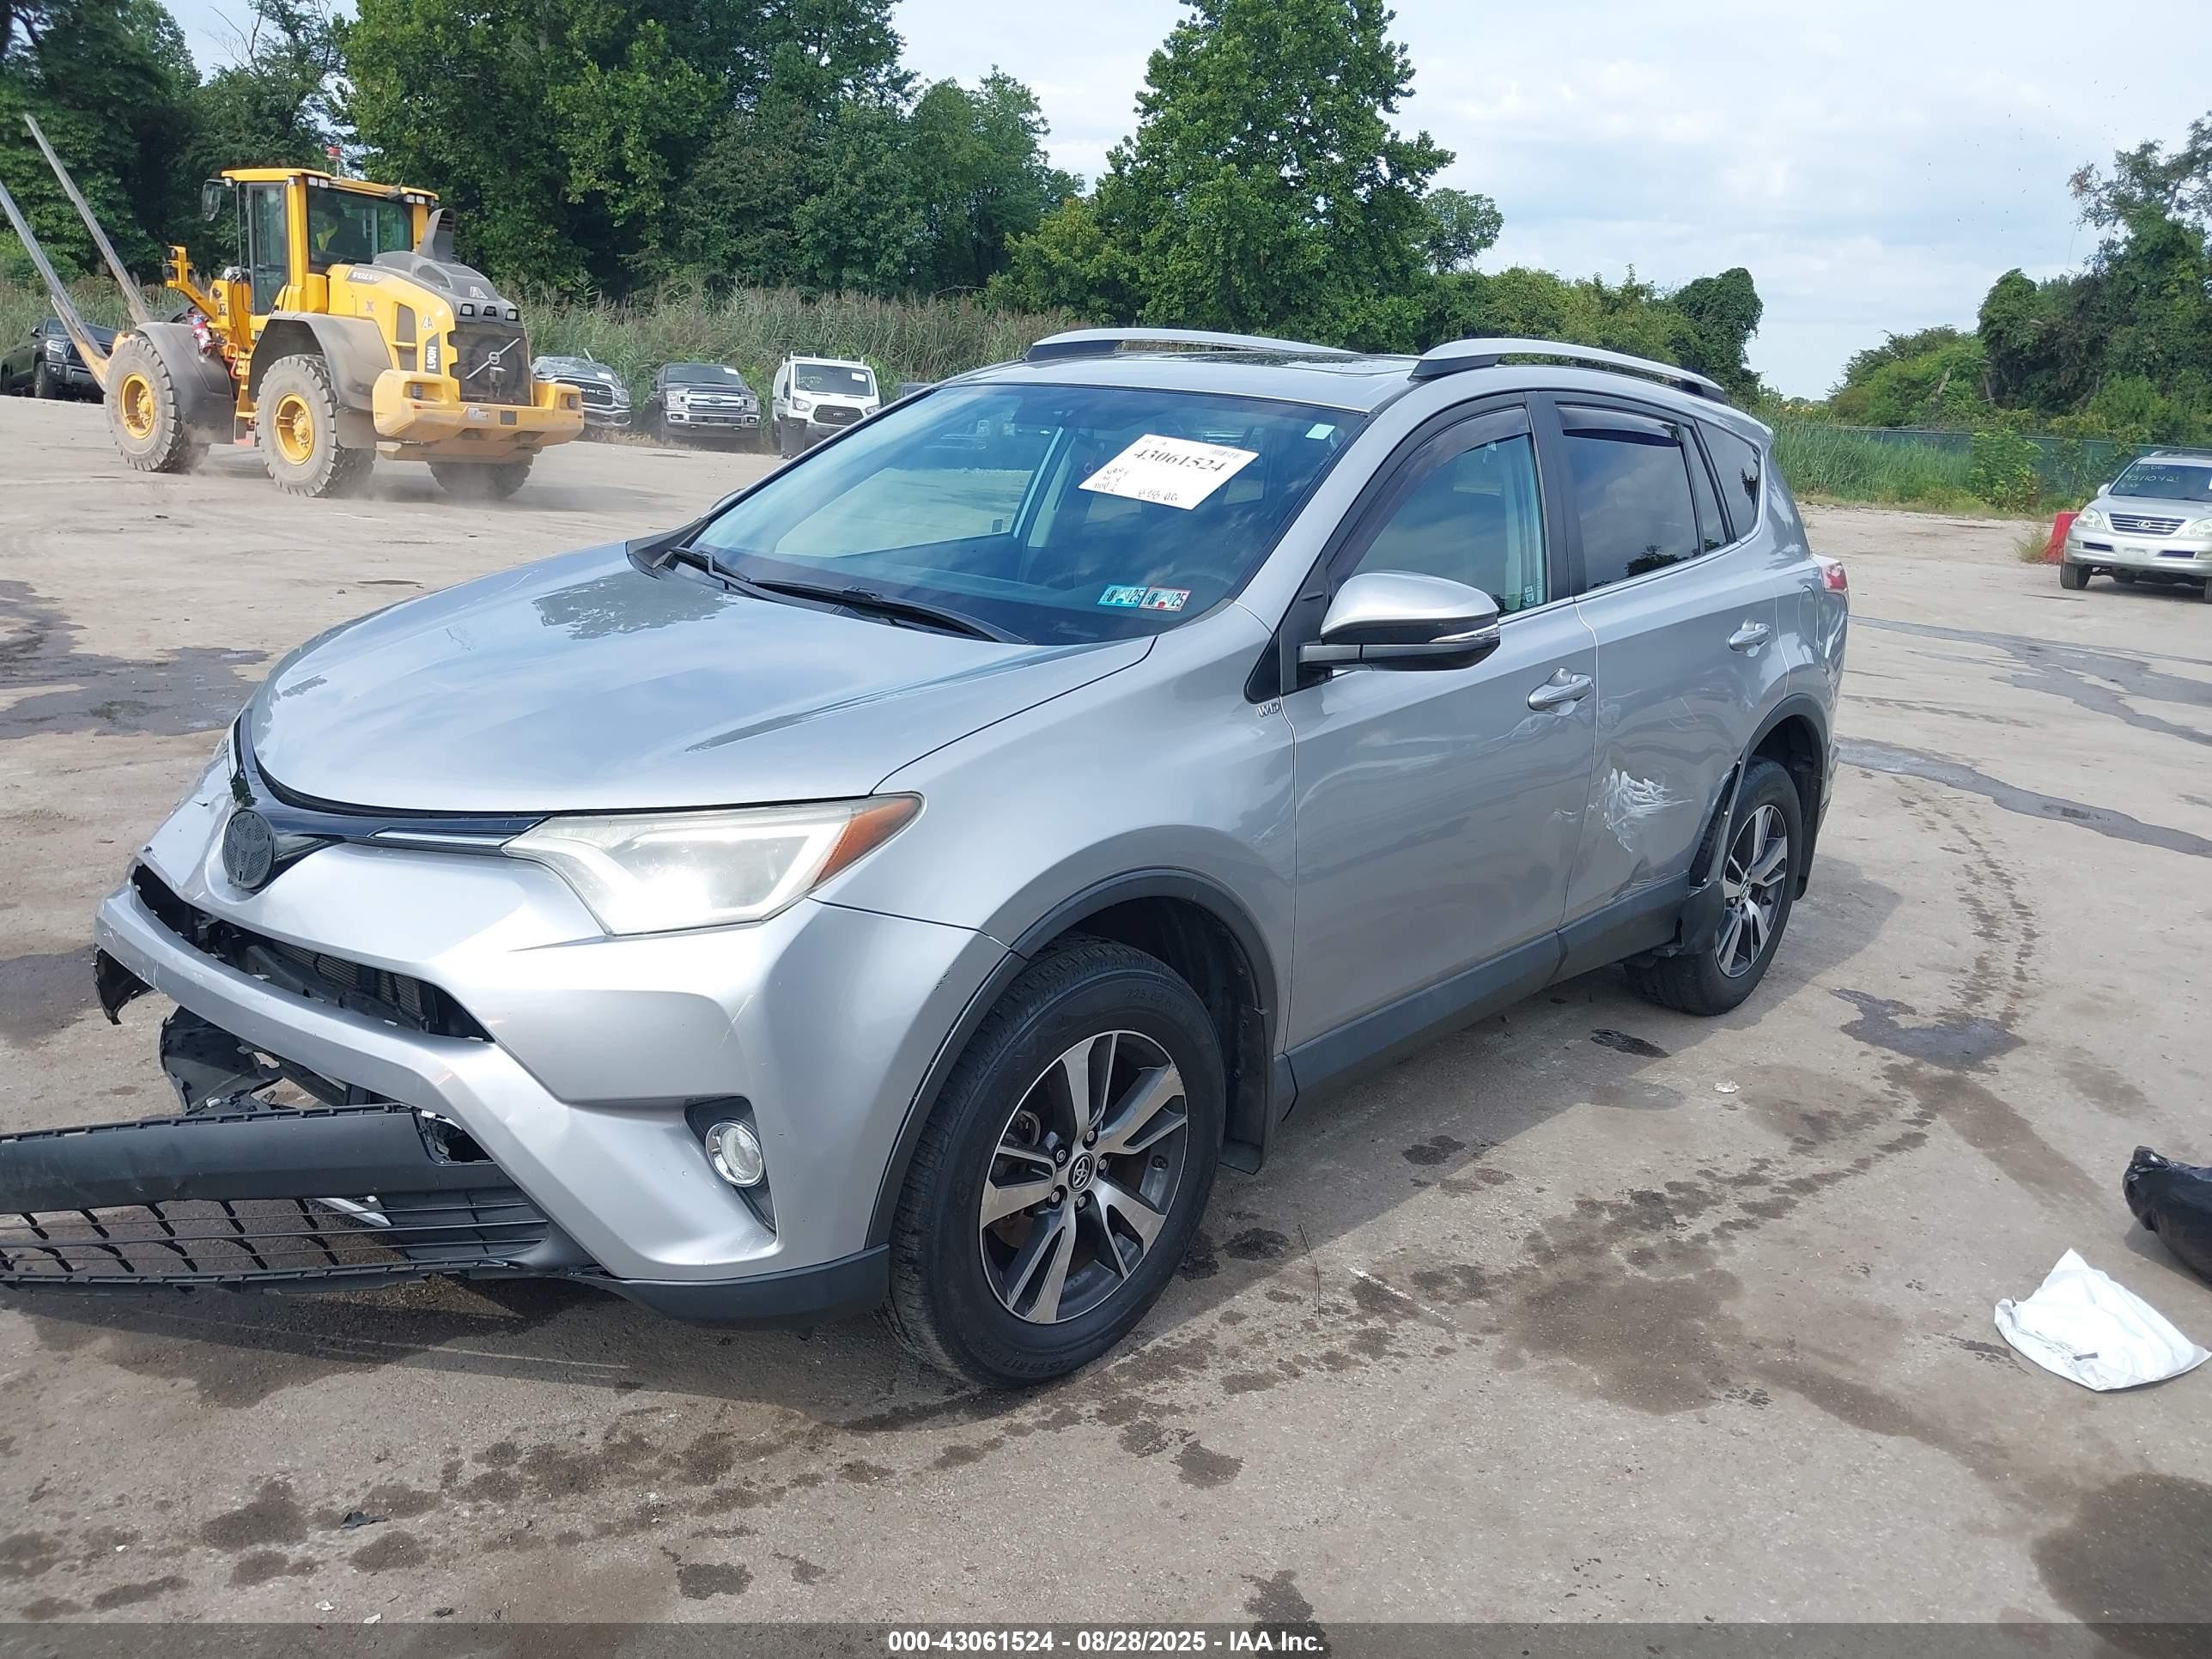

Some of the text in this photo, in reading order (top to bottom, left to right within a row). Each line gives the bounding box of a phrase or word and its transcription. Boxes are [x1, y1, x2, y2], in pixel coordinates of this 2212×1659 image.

[427, 346, 437, 370] L90H
[1133, 448, 1227, 472] 43061524
[1107, 589, 1144, 603] 8 25
[1148, 592, 1186, 607] 8 25
